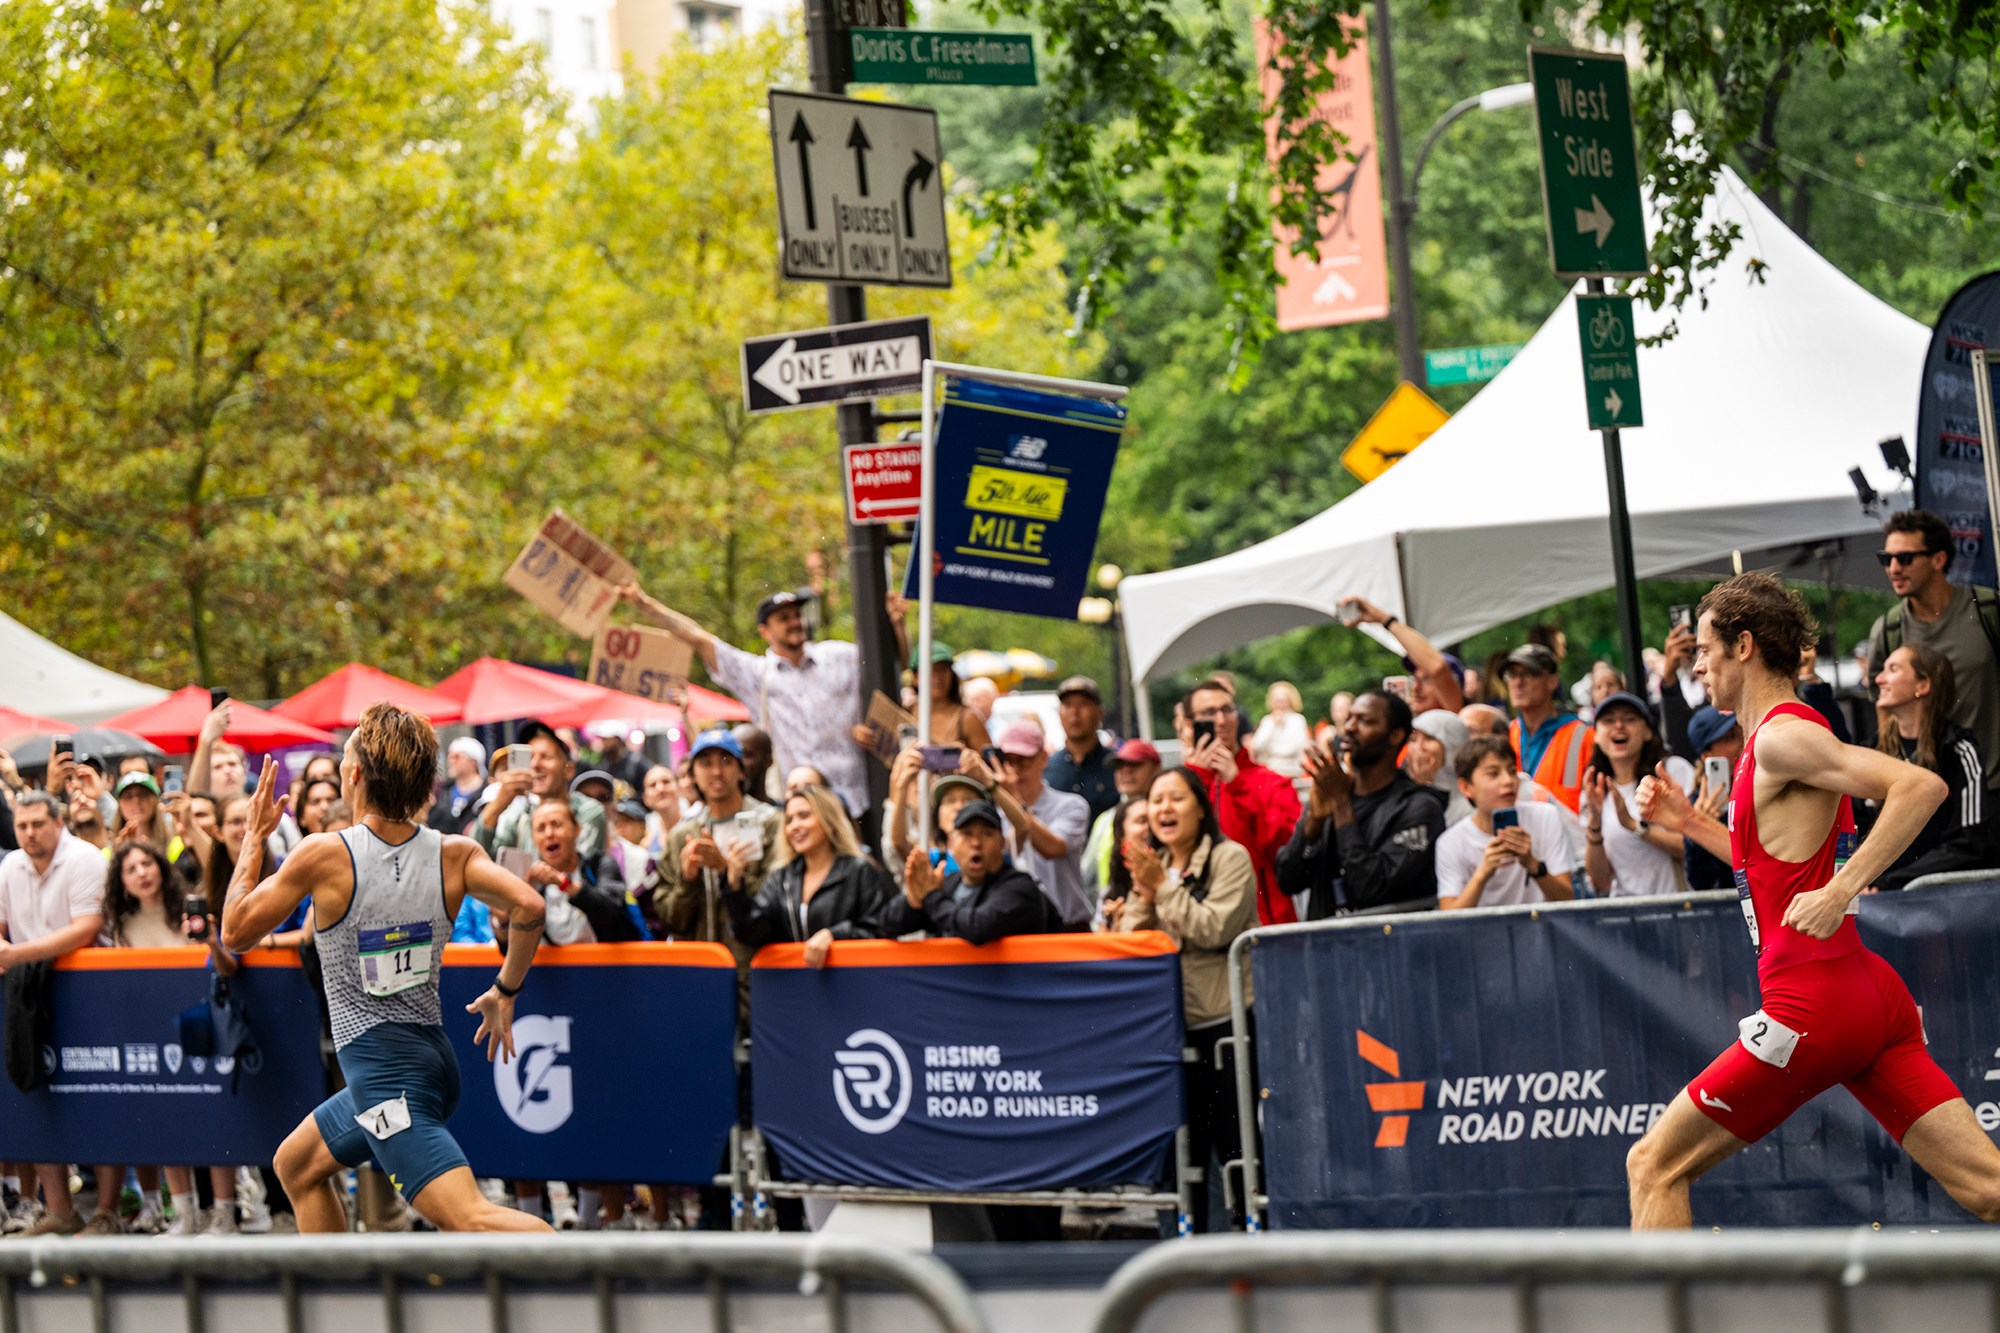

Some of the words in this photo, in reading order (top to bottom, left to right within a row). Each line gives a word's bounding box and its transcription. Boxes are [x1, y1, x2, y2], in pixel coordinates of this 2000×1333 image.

[852, 33, 907, 62] Doris
[931, 36, 1031, 65] Freedman
[1555, 77, 1610, 121] West
[1564, 135, 1614, 177] Side
[841, 204, 893, 235] BUSES
[790, 239, 835, 267] ONLY
[851, 244, 891, 271] ONLY
[902, 247, 945, 274] ONLY
[779, 353, 833, 384] ONE
[849, 343, 905, 374] WAY
[1615, 361, 1633, 379] Park
[852, 453, 874, 470] NO
[855, 469, 913, 488] Anytime
[977, 478, 1015, 503] 5th
[968, 513, 1047, 553] MILE
[605, 629, 641, 660] GO
[394, 949, 412, 975] 11
[1750, 1021, 1768, 1047] 2
[924, 1045, 1001, 1068] RISING
[925, 1071, 977, 1093] NEW
[981, 1070, 1043, 1093] YORK
[1437, 1074, 1512, 1109] NEW
[1516, 1069, 1607, 1104] YORK
[926, 1096, 989, 1118] ROAD
[993, 1095, 1100, 1118] RUNNERS
[1438, 1110, 1526, 1145] ROAD
